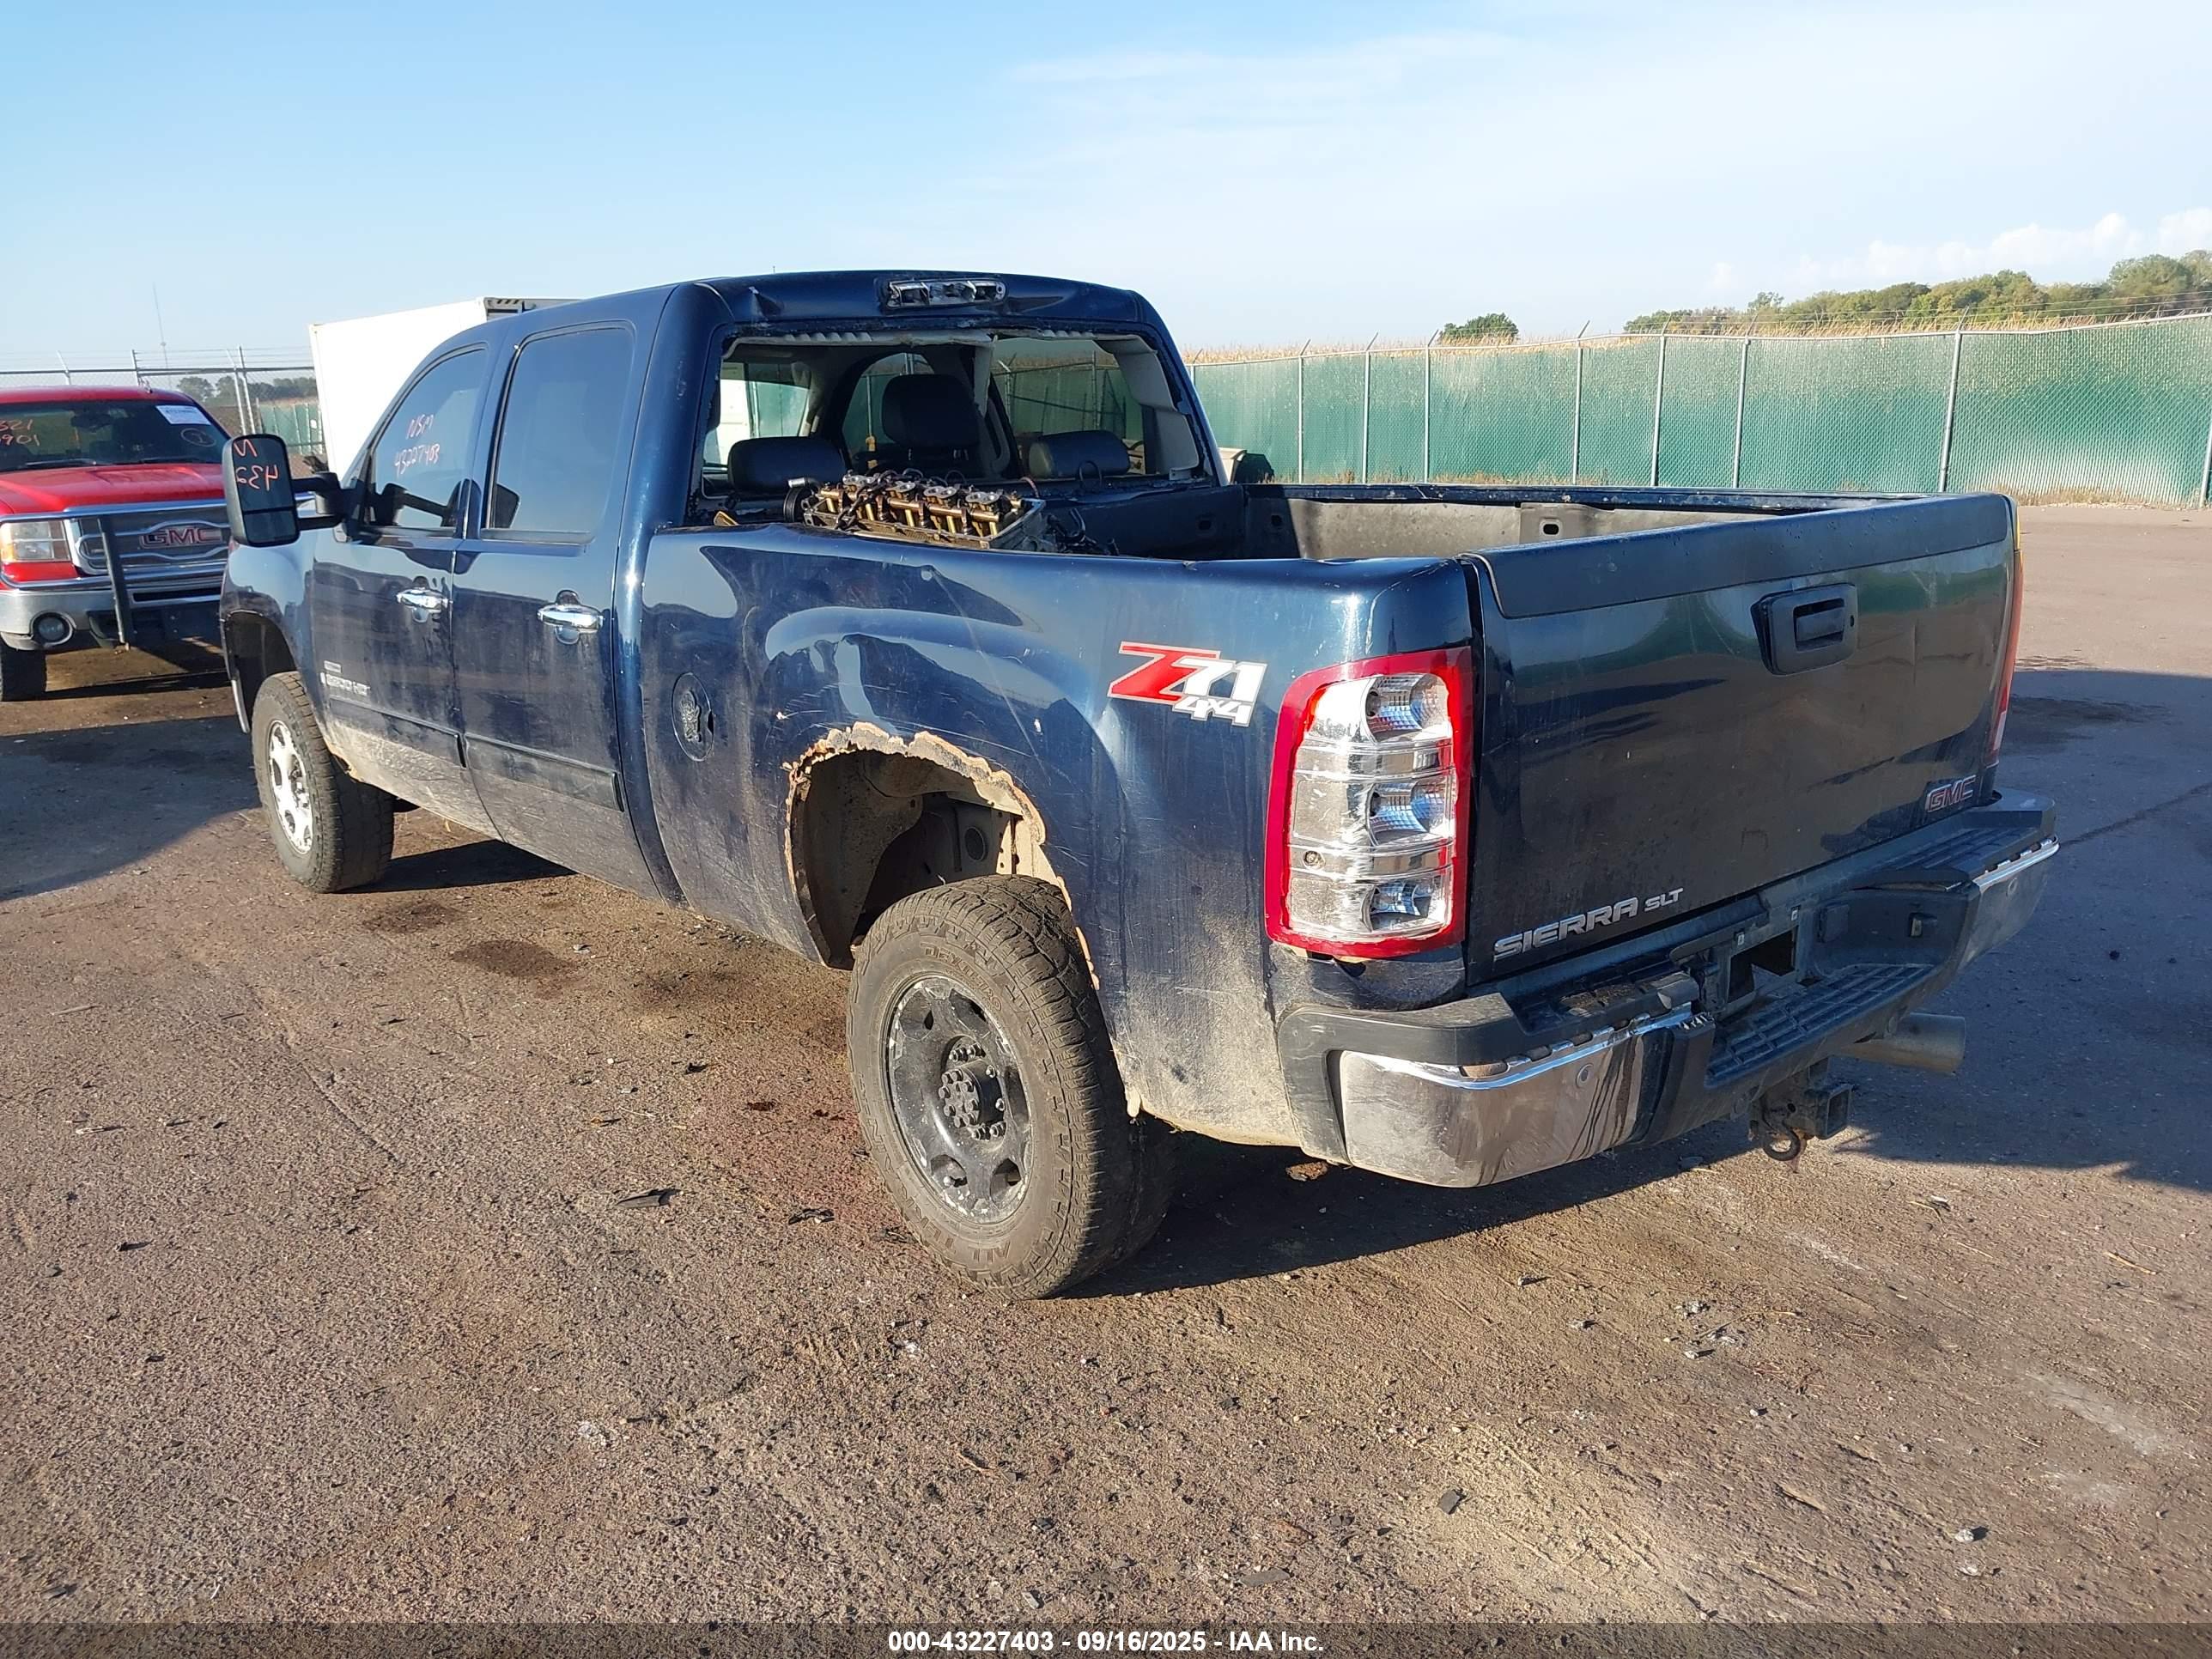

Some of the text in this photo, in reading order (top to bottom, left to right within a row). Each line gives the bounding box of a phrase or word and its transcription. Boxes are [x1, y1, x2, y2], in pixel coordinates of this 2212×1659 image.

[139, 527, 222, 549] GMC
[1107, 641, 1267, 706] Z71
[1925, 775, 1977, 812] GMC
[1493, 887, 1684, 962] SIERRA SLT
